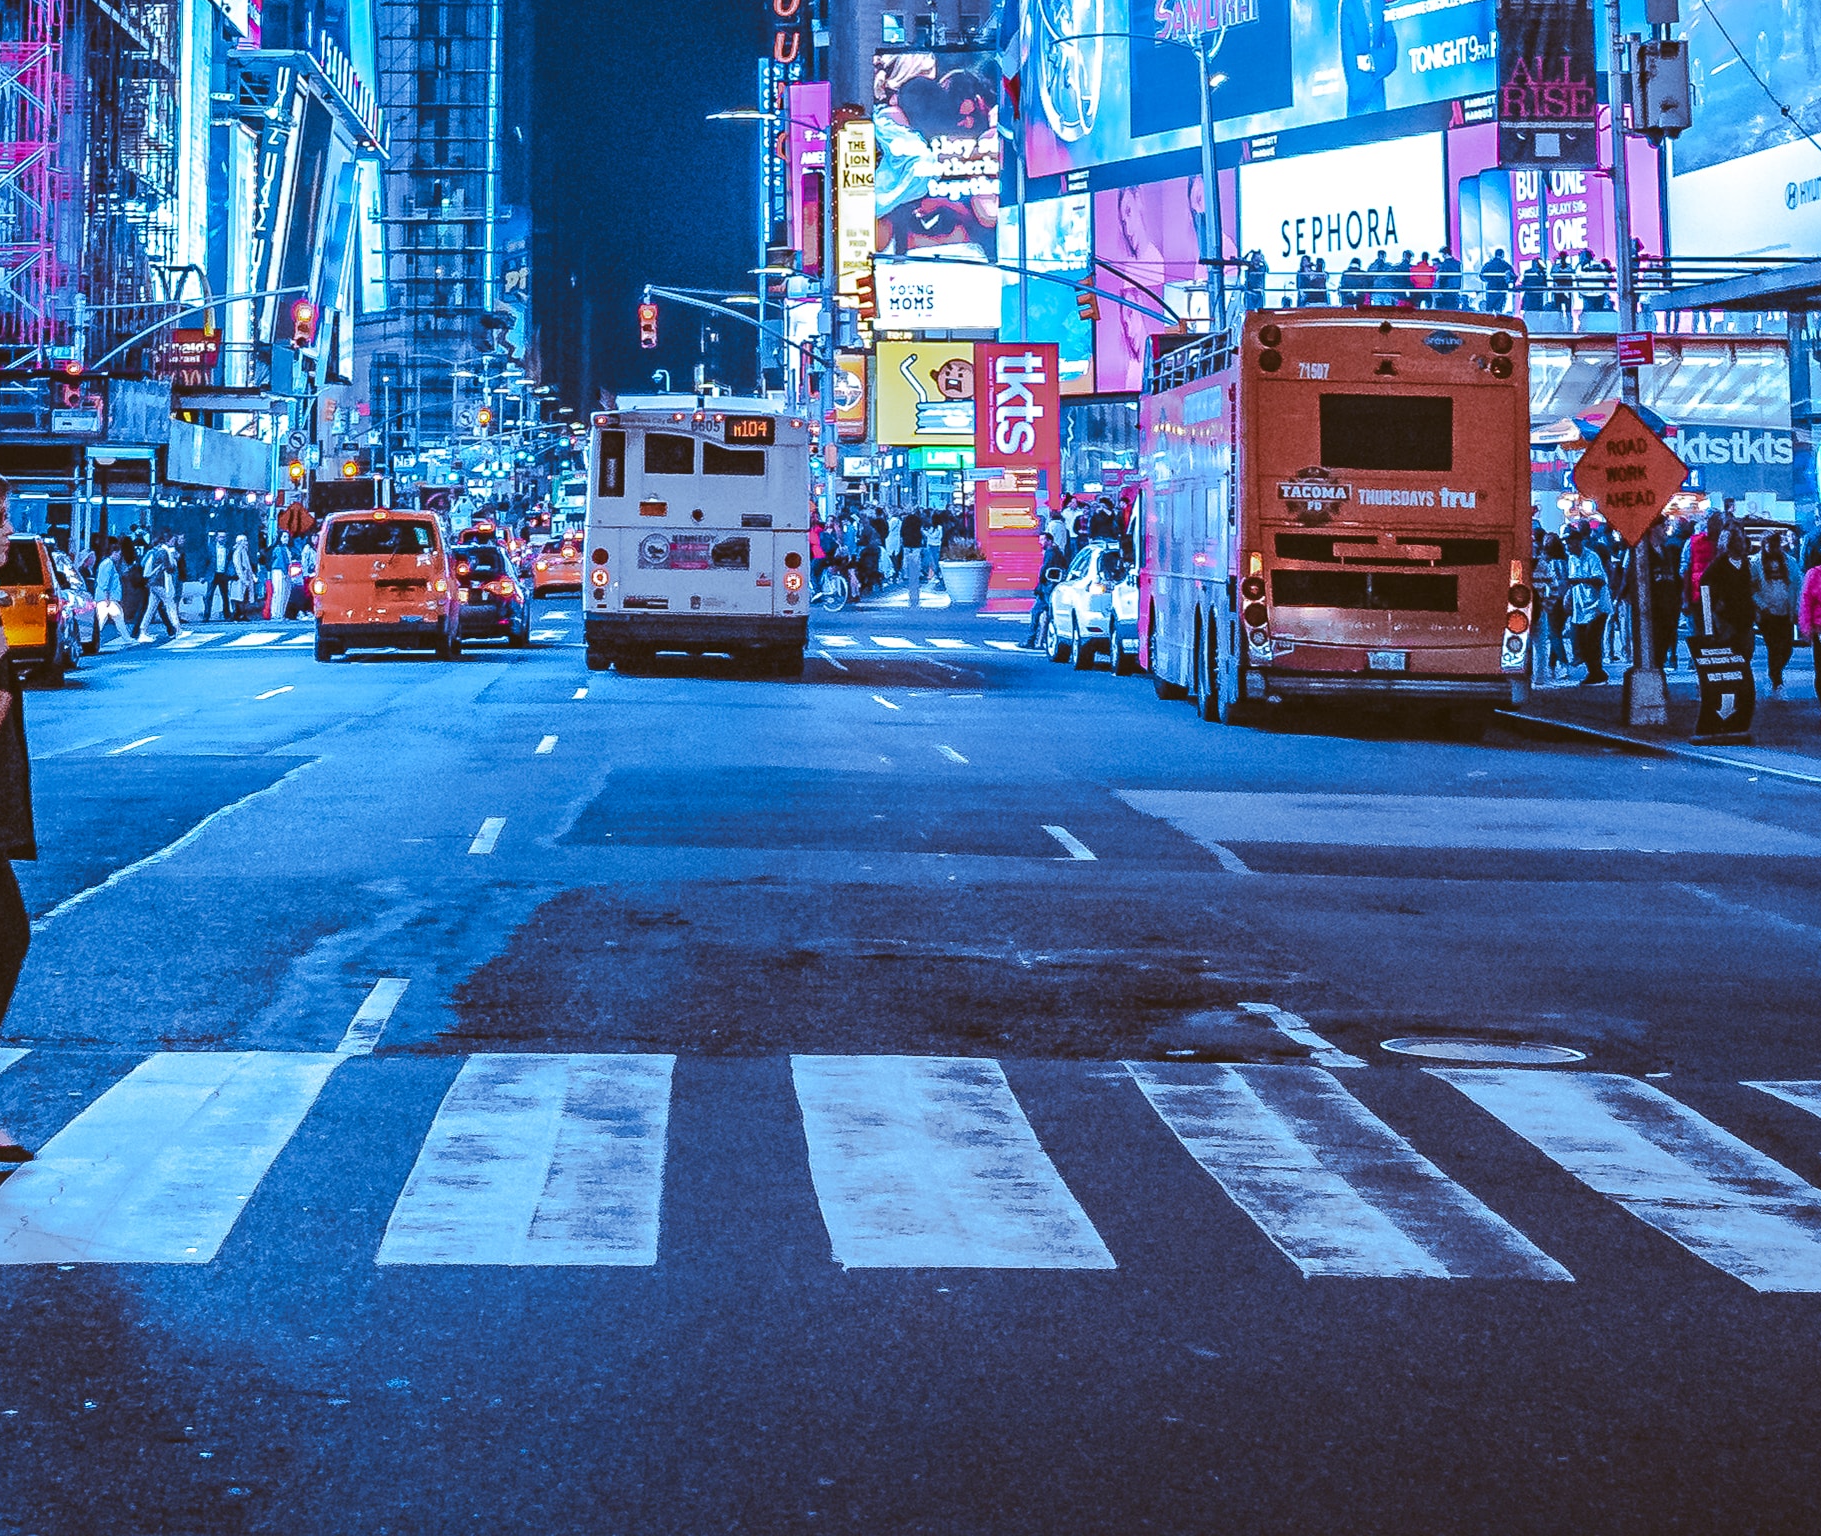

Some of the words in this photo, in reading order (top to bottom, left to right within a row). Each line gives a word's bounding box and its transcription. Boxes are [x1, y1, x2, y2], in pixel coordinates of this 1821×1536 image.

[1407, 36, 1469, 75] TONIGHT
[1508, 55, 1587, 86] ALL
[1500, 85, 1595, 118] RISE
[847, 140, 866, 151] THE
[844, 152, 871, 168] LION
[842, 168, 874, 188] KING
[1551, 170, 1588, 198] ONE
[1281, 205, 1399, 258] SEPHORA
[1552, 216, 1589, 251] ONE
[889, 297, 934, 310] MOMS
[995, 352, 1046, 455] tkts
[1606, 437, 1648, 457] ROAD
[1605, 465, 1648, 484] WORK
[1279, 484, 1347, 500] TACOMA
[1358, 488, 1435, 508] THURSDAYS
[1439, 486, 1477, 509] tru
[1605, 491, 1655, 511] AHEAD
[1306, 501, 1322, 512] FD
